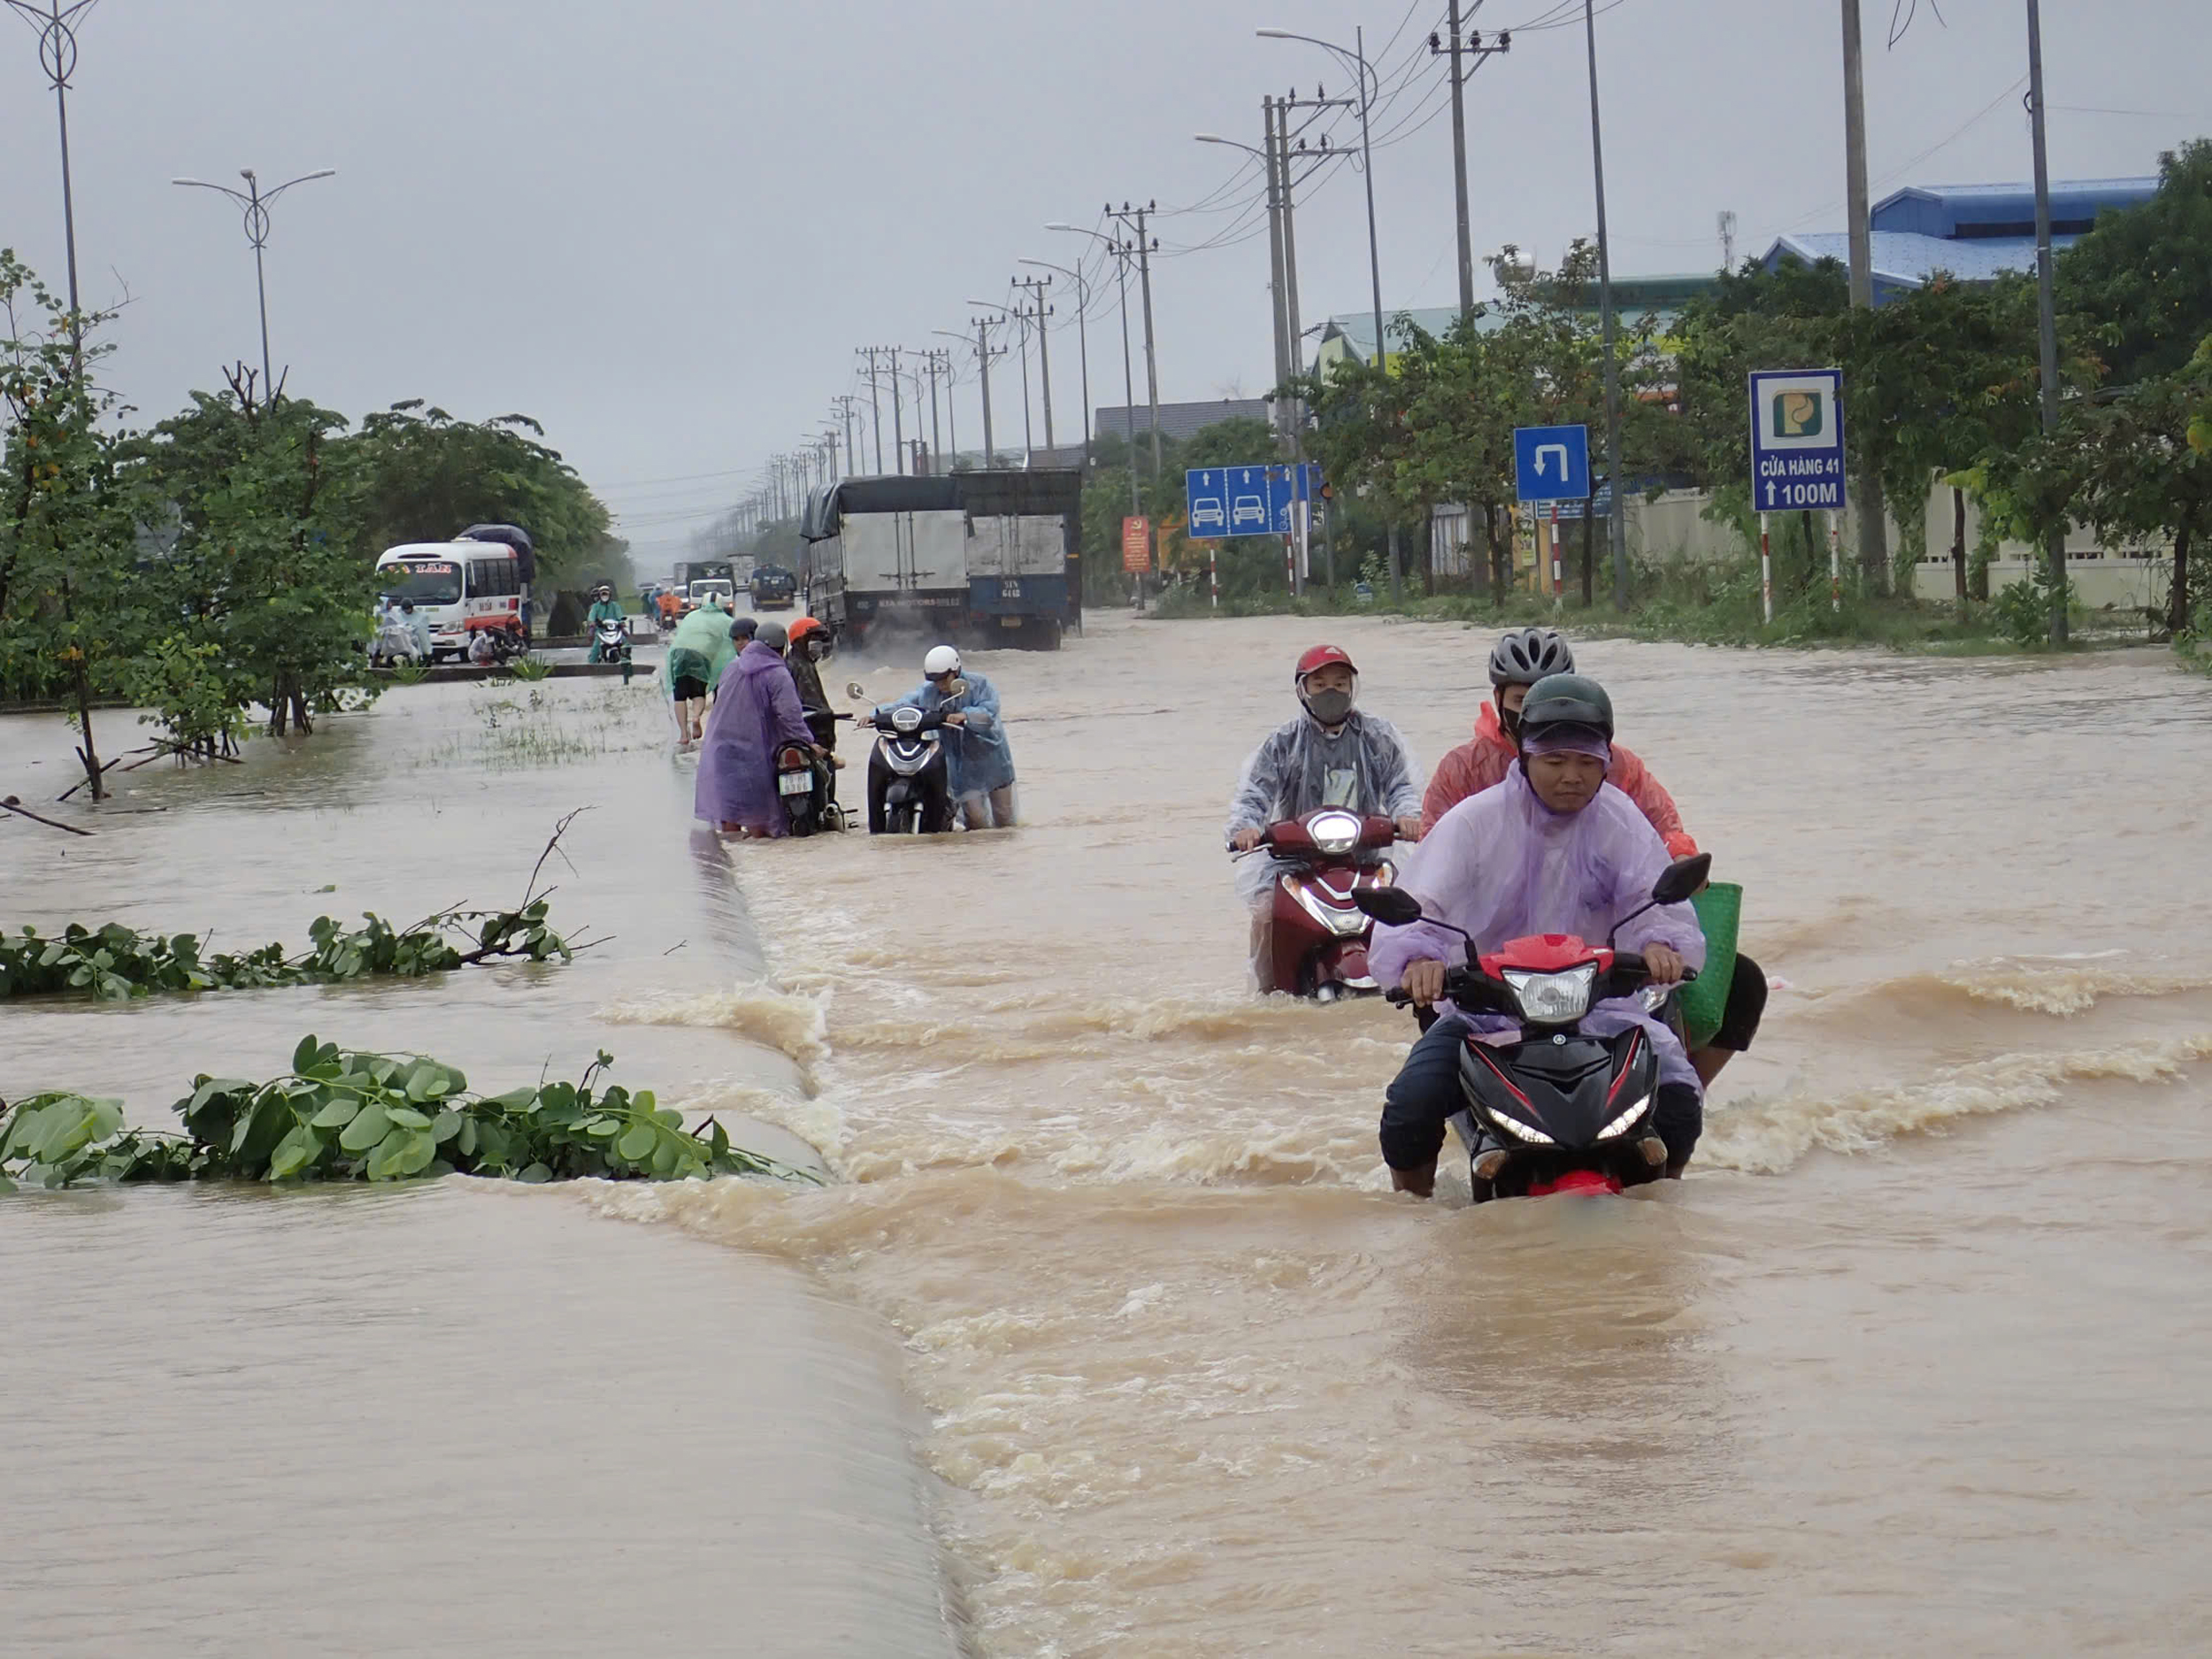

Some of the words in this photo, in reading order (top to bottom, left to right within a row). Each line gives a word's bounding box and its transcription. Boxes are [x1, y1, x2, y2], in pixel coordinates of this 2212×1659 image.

[1761, 455, 1786, 477] CỬA
[1788, 456, 1823, 476] HÀNG
[1825, 458, 1839, 474] 41
[1782, 483, 1837, 504] 100M
